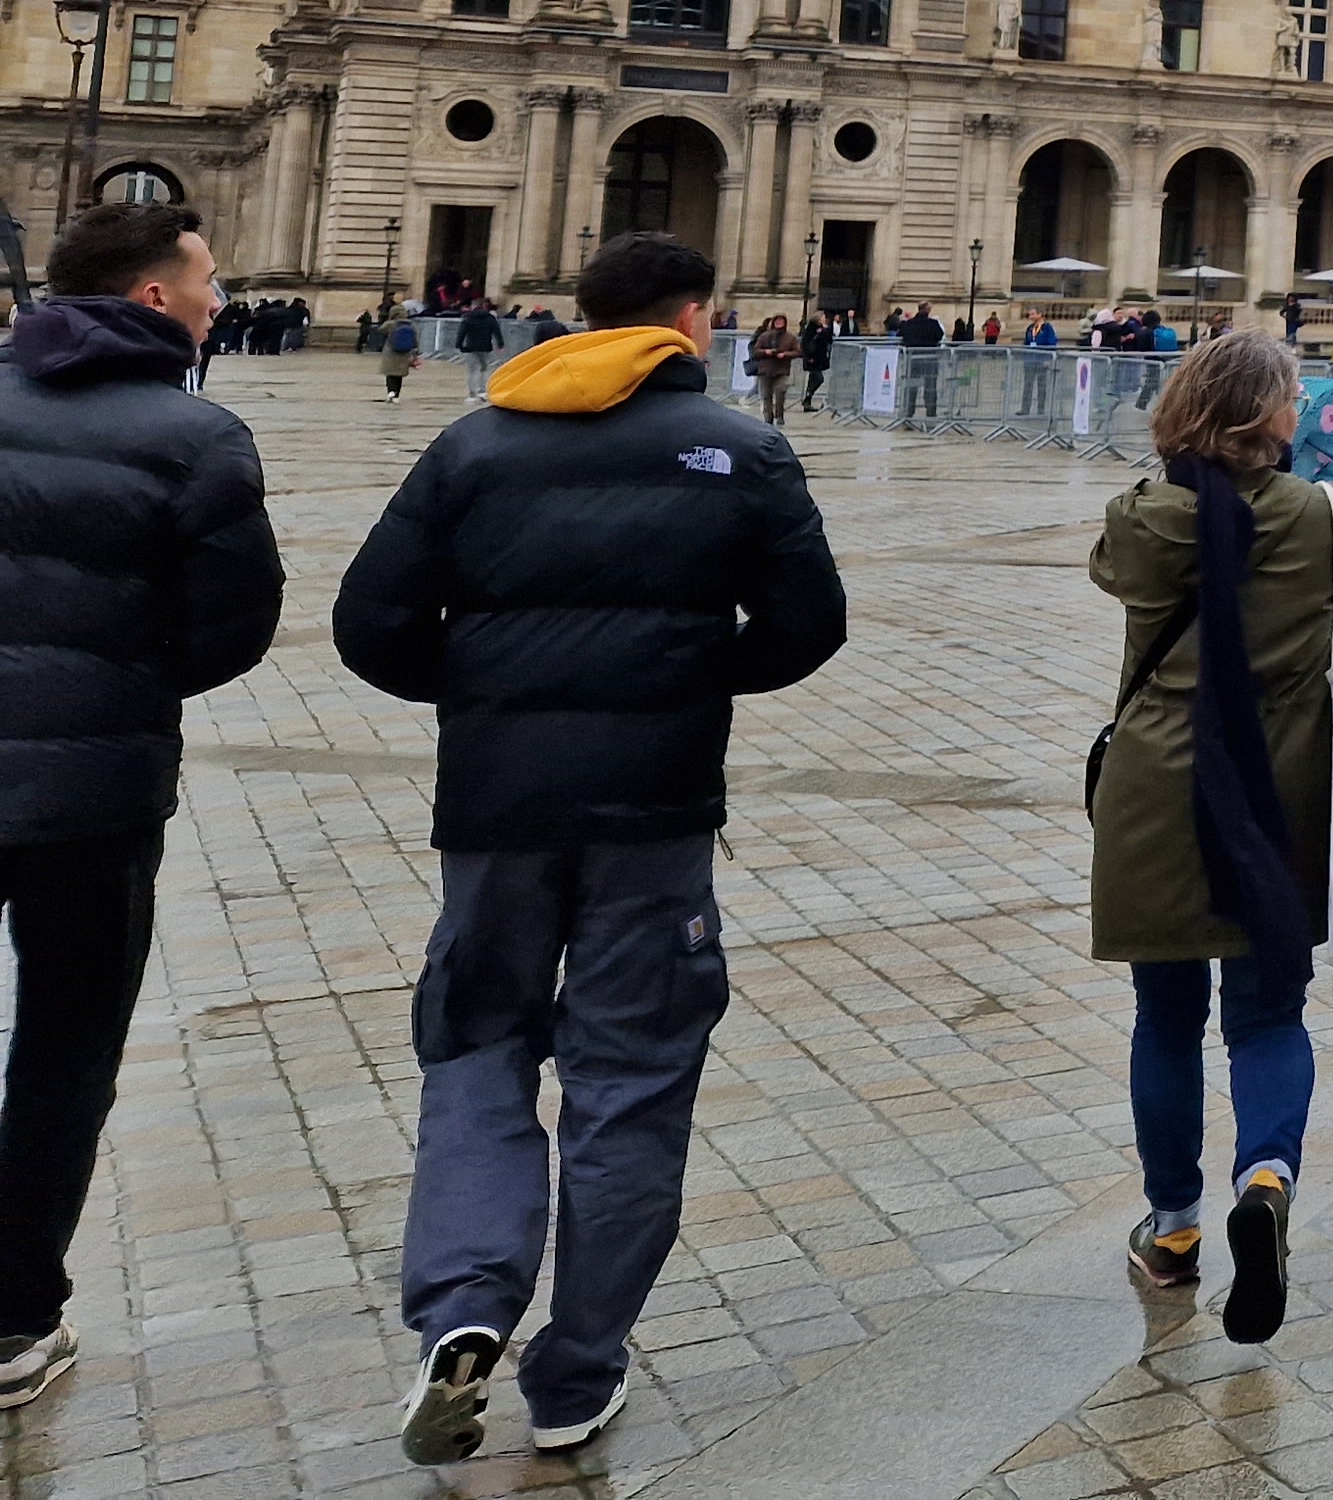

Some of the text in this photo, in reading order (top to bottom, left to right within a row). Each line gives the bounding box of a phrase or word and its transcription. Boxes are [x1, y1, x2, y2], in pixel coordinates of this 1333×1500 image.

[693, 445, 715, 457] THE
[677, 452, 713, 465] NORTH
[686, 459, 713, 472] FACE
